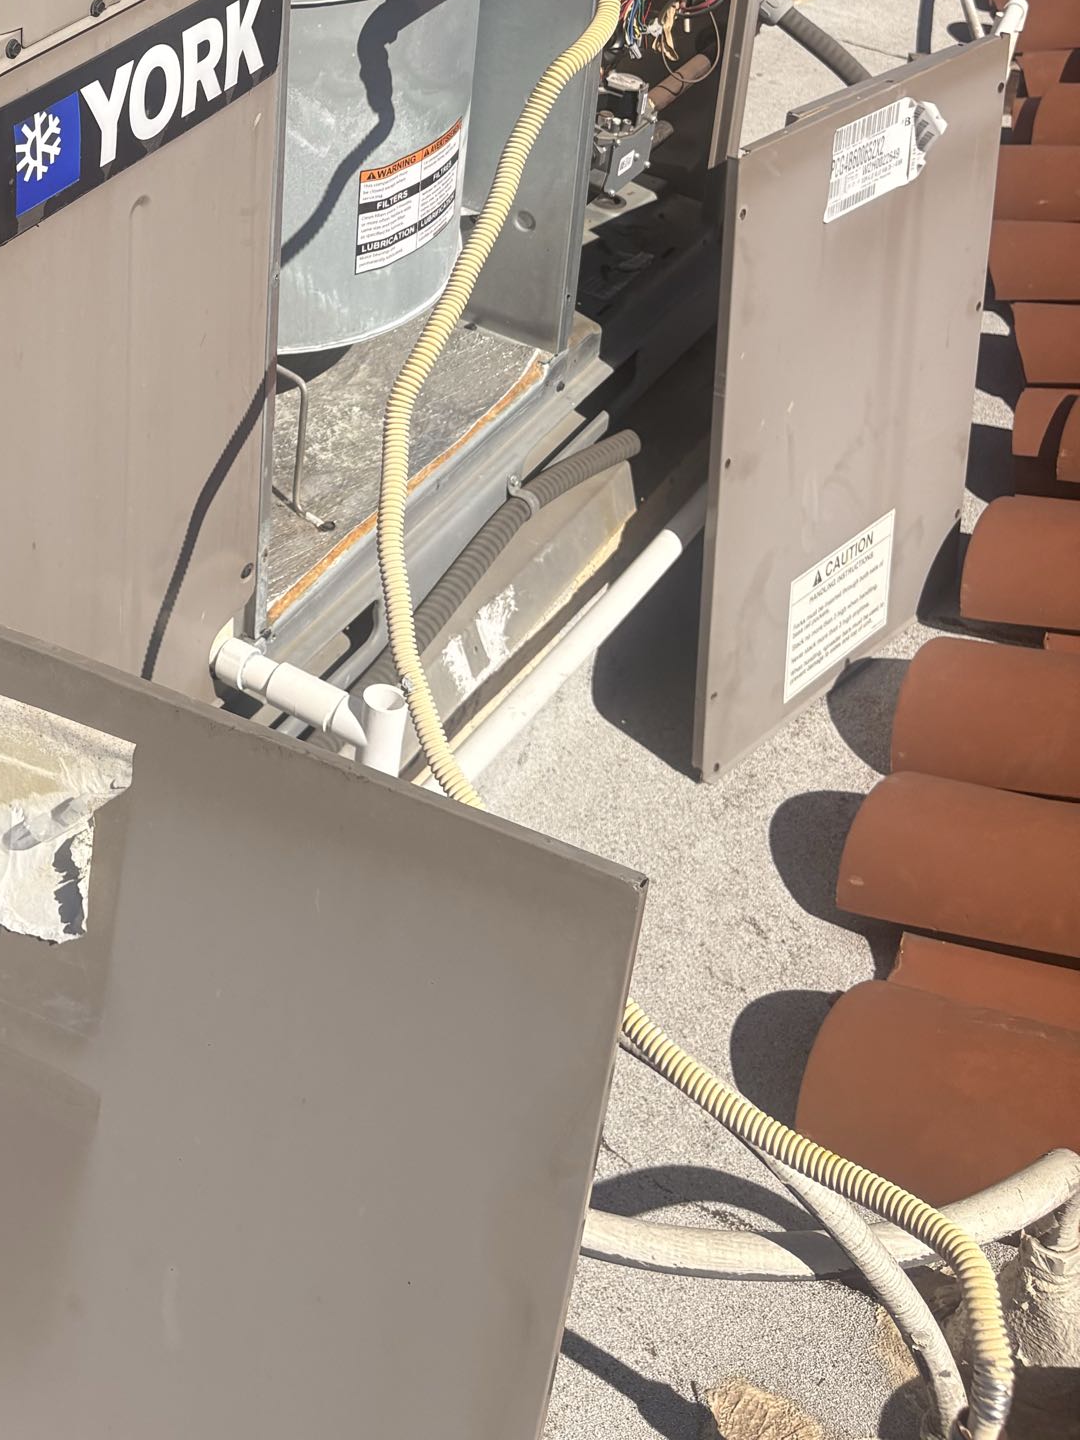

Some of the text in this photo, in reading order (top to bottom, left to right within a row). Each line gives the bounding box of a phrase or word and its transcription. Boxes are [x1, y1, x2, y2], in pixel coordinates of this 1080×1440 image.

[377, 155, 416, 179] WARNING
[376, 190, 408, 210] FILTERS
[361, 224, 415, 253] LUBRICATION
[825, 531, 874, 577] CAUTION
